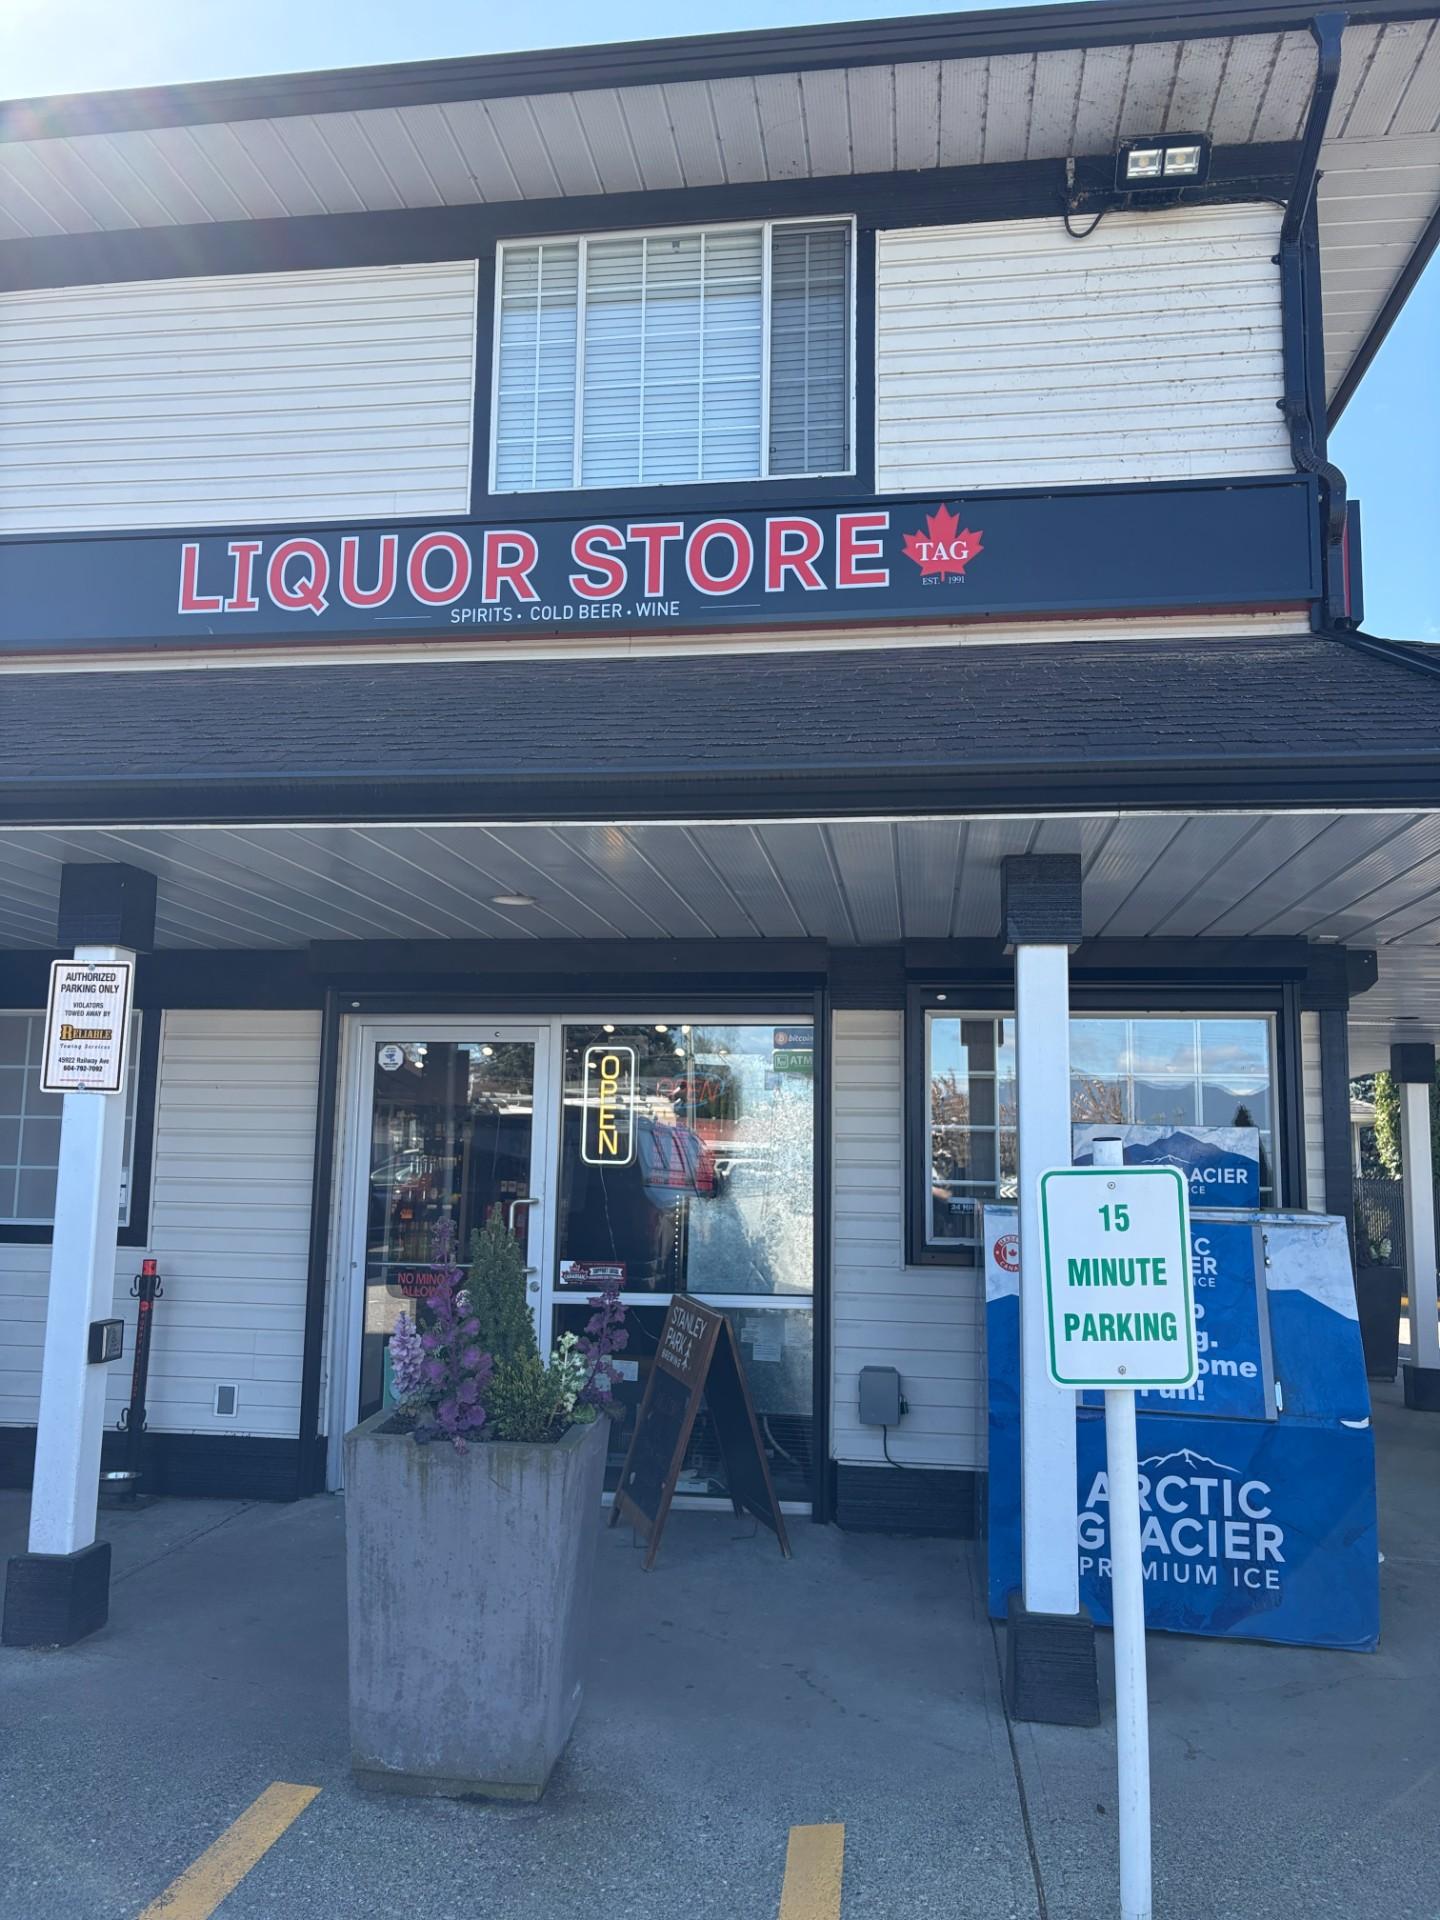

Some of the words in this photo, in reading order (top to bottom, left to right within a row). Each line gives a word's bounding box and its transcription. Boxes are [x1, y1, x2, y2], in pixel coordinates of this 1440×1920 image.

[178, 530, 541, 616] LIQUOR
[569, 511, 890, 601] STORE
[915, 541, 969, 561] TAG
[922, 577, 940, 586] EST.
[948, 575, 965, 584] 1991
[530, 605, 573, 620] COLD
[579, 603, 622, 619] BEER
[636, 601, 680, 617] WINE
[60, 984, 96, 993] PARKING
[98, 985, 119, 993] ONLY
[65, 972, 116, 982] AUTHORIZED
[77, 1057, 97, 1065] Railway
[791, 1056, 813, 1065] ATM
[599, 1055, 620, 1154] OPEN
[1098, 1204, 1130, 1232] 15
[398, 1273, 414, 1284] NO
[1067, 1257, 1168, 1286] MINUTE
[672, 1306, 708, 1339] STANLEY
[1064, 1312, 1178, 1341] PARKING
[665, 1327, 688, 1354] PARK
[1077, 1512, 1286, 1563] GACIER
[1079, 1557, 1217, 1586] PRMIUM
[1234, 1567, 1280, 1590] ICE
